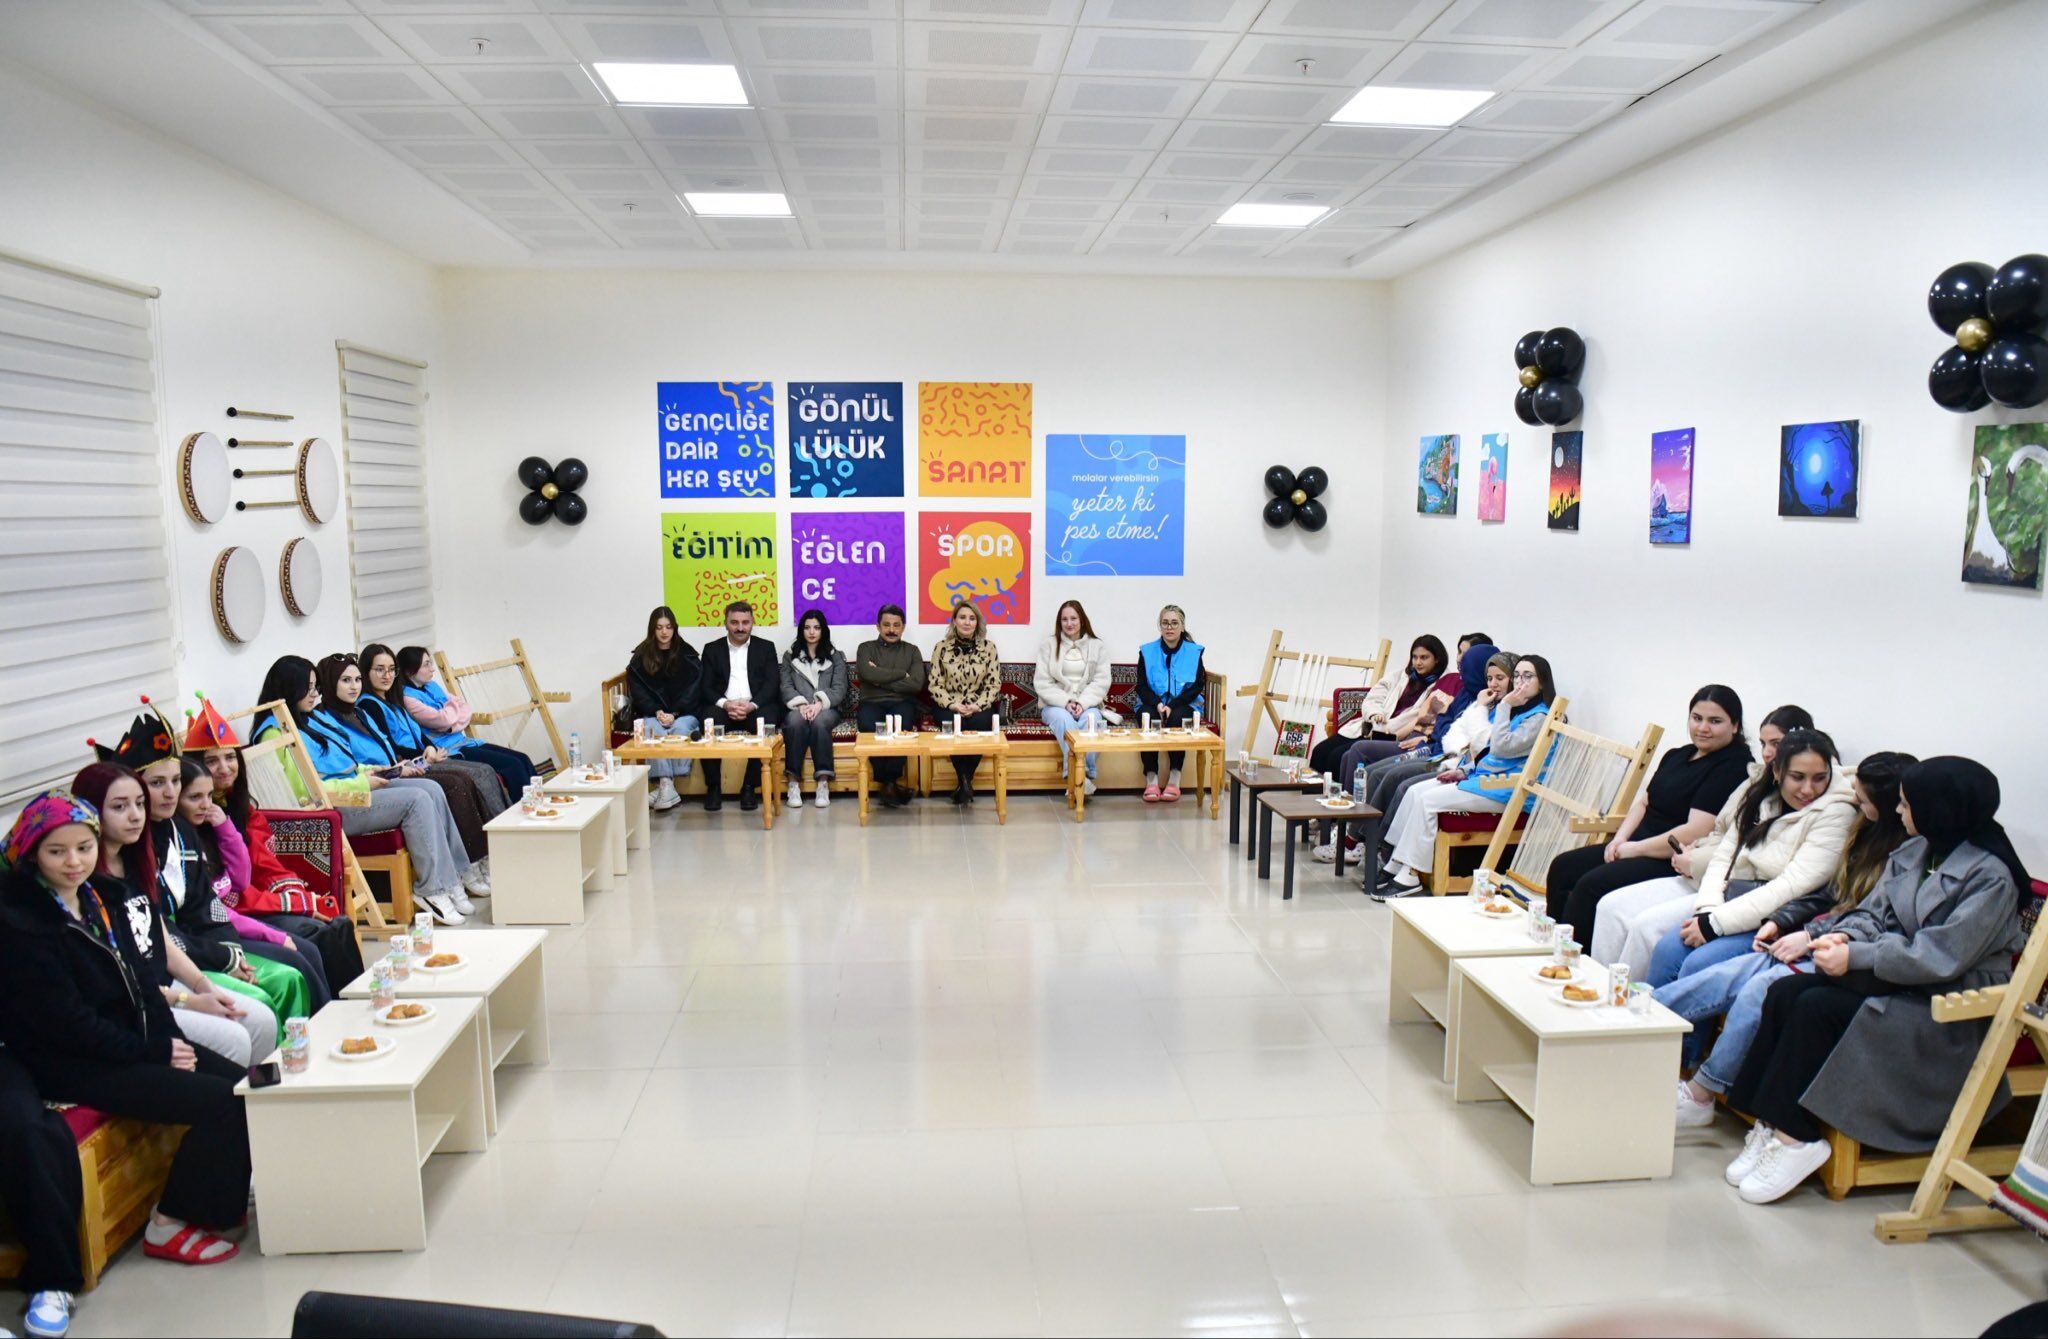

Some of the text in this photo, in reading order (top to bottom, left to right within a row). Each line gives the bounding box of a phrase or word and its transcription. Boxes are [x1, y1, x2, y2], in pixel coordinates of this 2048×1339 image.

[798, 392, 894, 423] GÖNÜL
[664, 409, 770, 436] GENÇLİĞE
[665, 437, 719, 460] DAİR
[799, 428, 886, 460] LÜLÜK
[666, 469, 759, 493] HER ŞEY
[928, 460, 1026, 484] SANAT
[1072, 473, 1159, 482] molalar verebilirsin
[1069, 485, 1155, 521] yeter ki
[1060, 513, 1170, 548] pes etme!
[672, 530, 773, 560] EĞİTİM
[800, 534, 886, 565] EĞLEN
[937, 533, 1014, 557] SPOR
[801, 577, 836, 601] CE
[1286, 731, 1304, 743] GSB
